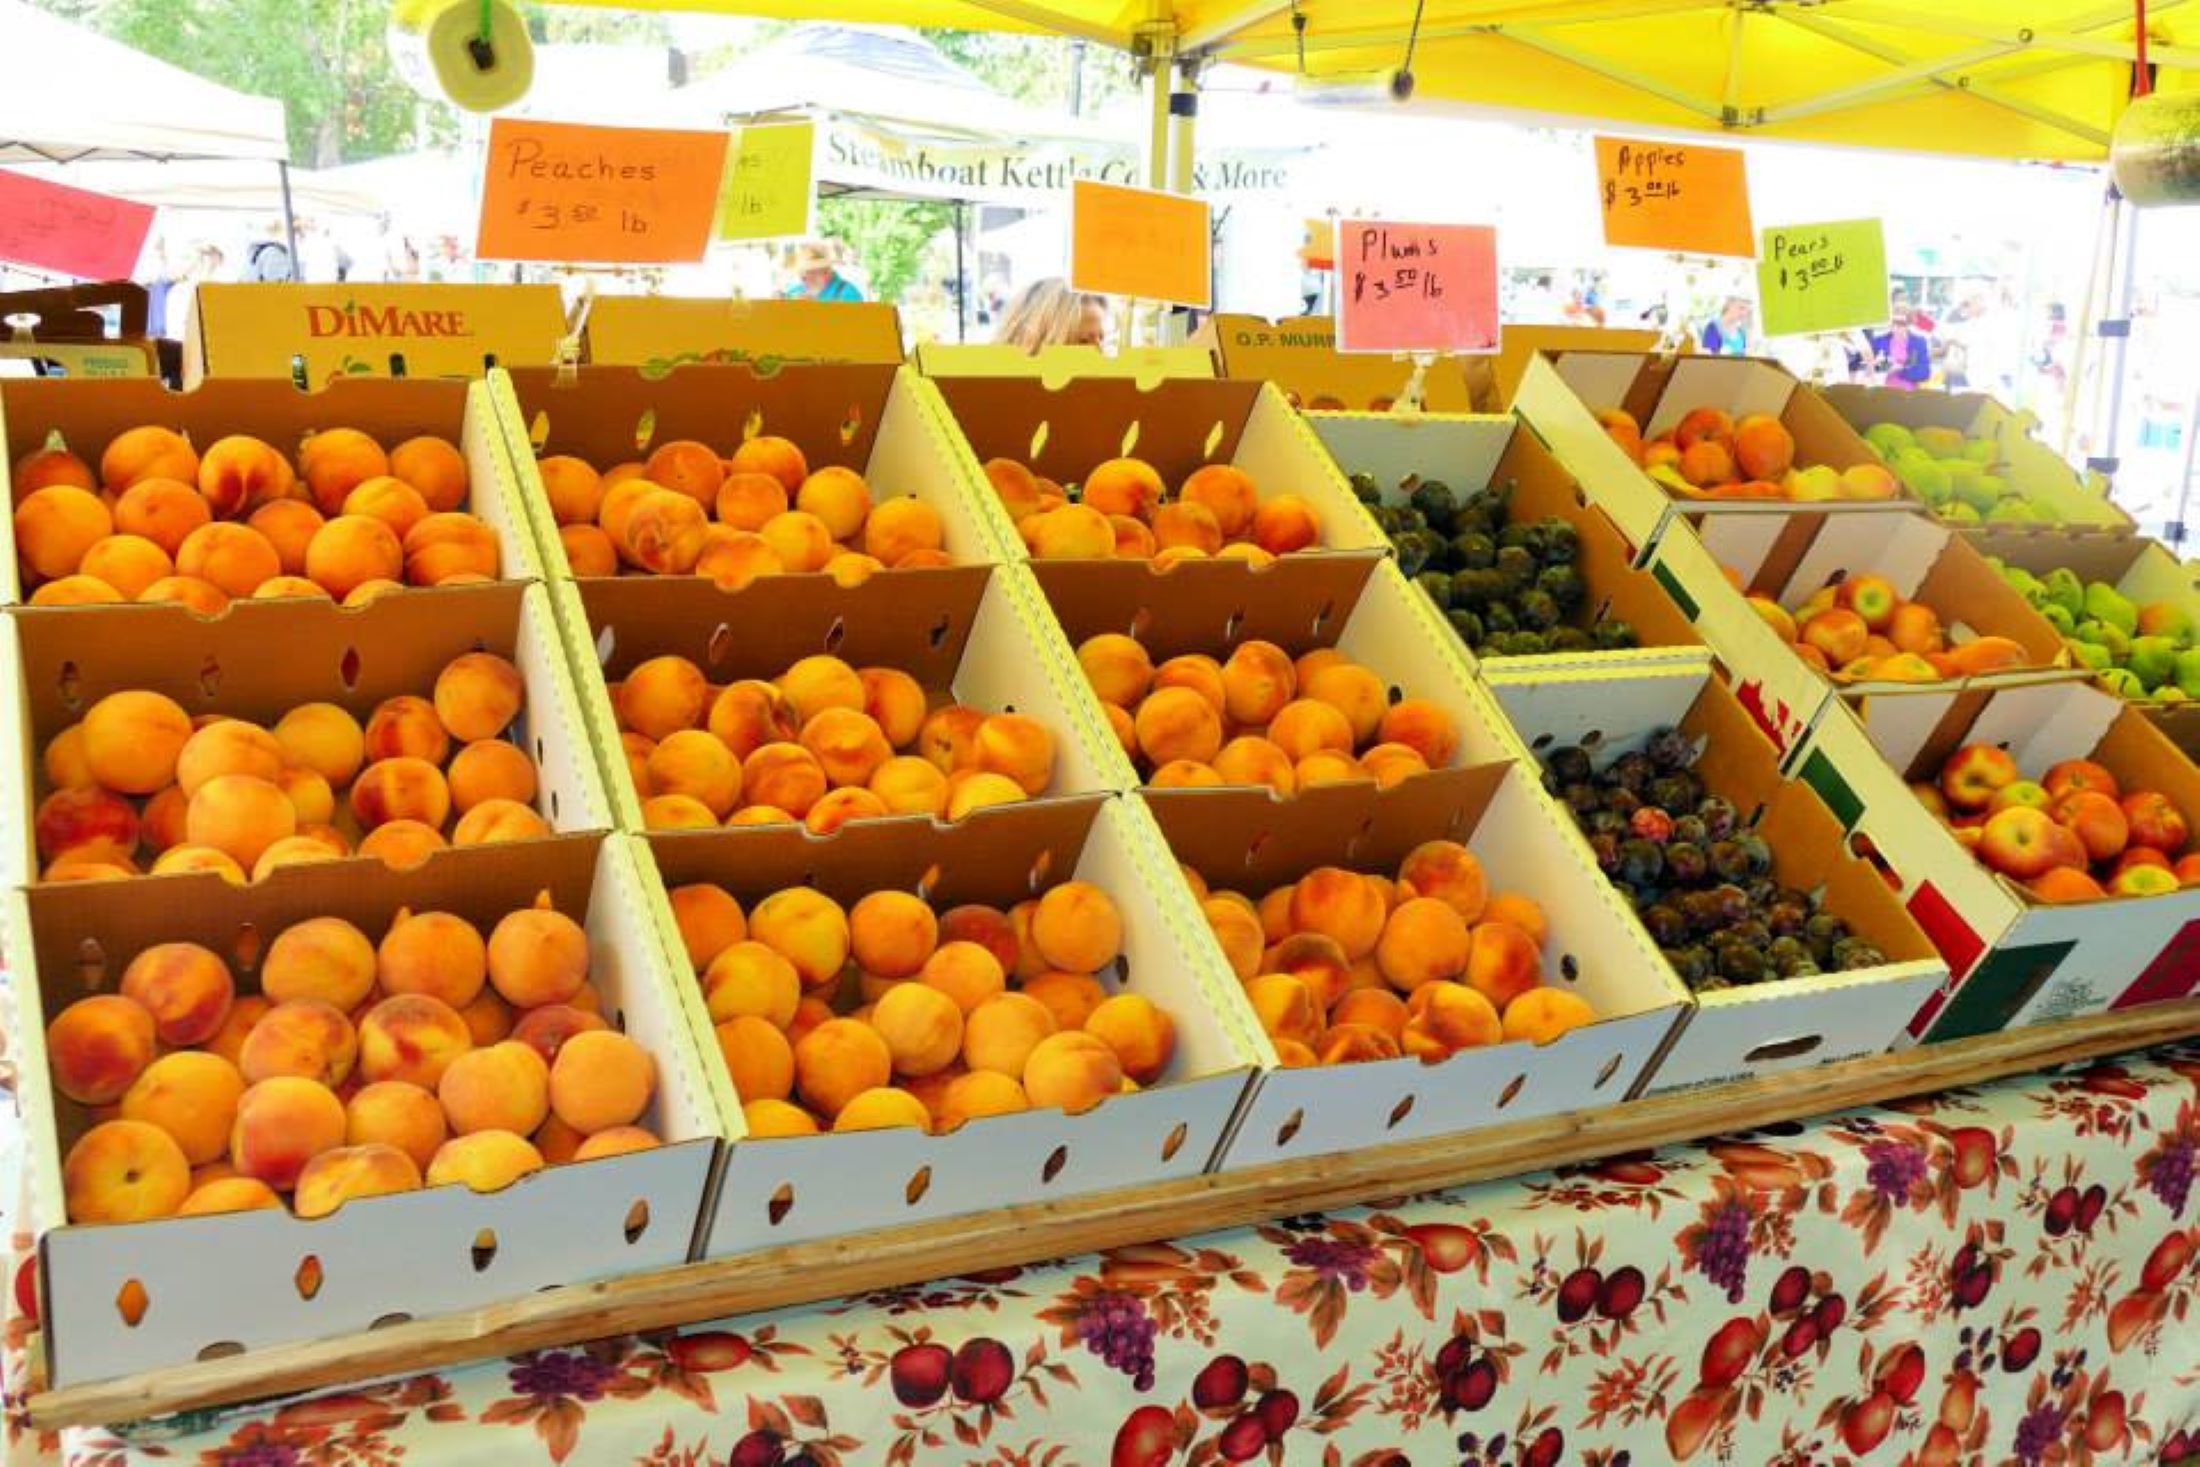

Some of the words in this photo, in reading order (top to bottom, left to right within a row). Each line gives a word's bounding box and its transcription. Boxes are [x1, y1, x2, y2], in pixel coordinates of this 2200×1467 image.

[507, 138, 657, 180] Peaches
[828, 131, 987, 187] Steamboat
[1214, 161, 1288, 190] More
[1618, 145, 1685, 176] Apples
[740, 193, 763, 215] lb
[621, 211, 649, 234] lb
[1362, 229, 1438, 262] Plums
[1774, 234, 1829, 261] Pears
[1422, 271, 1443, 300] lb
[305, 299, 472, 338] DiMARE
